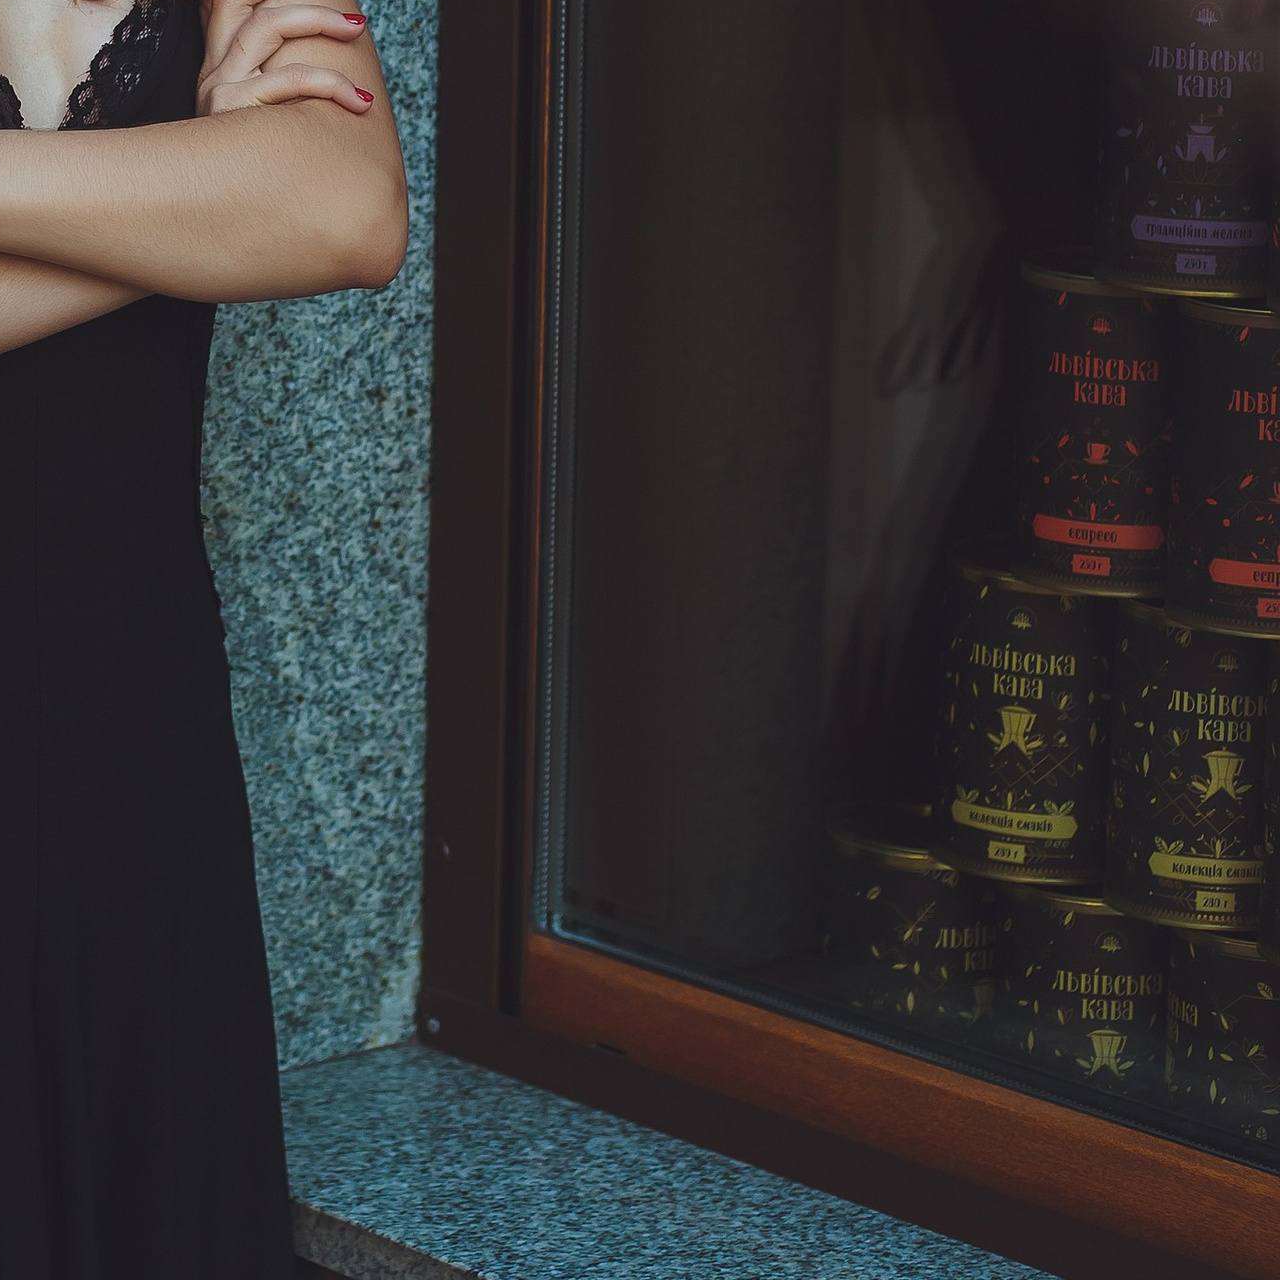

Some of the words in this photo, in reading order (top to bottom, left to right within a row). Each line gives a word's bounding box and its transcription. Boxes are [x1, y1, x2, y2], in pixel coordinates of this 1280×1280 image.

[1177, 74, 1233, 99] кава
[1048, 349, 1159, 382] львівська
[1074, 380, 1126, 407] кава
[1068, 527, 1118, 543] еспресо
[969, 642, 1076, 677] львівська
[993, 673, 1044, 700] кава
[1197, 718, 1253, 743] кава
[1172, 862, 1223, 879] колекція
[1051, 967, 1163, 997] львівська
[1081, 997, 1135, 1022] кава
